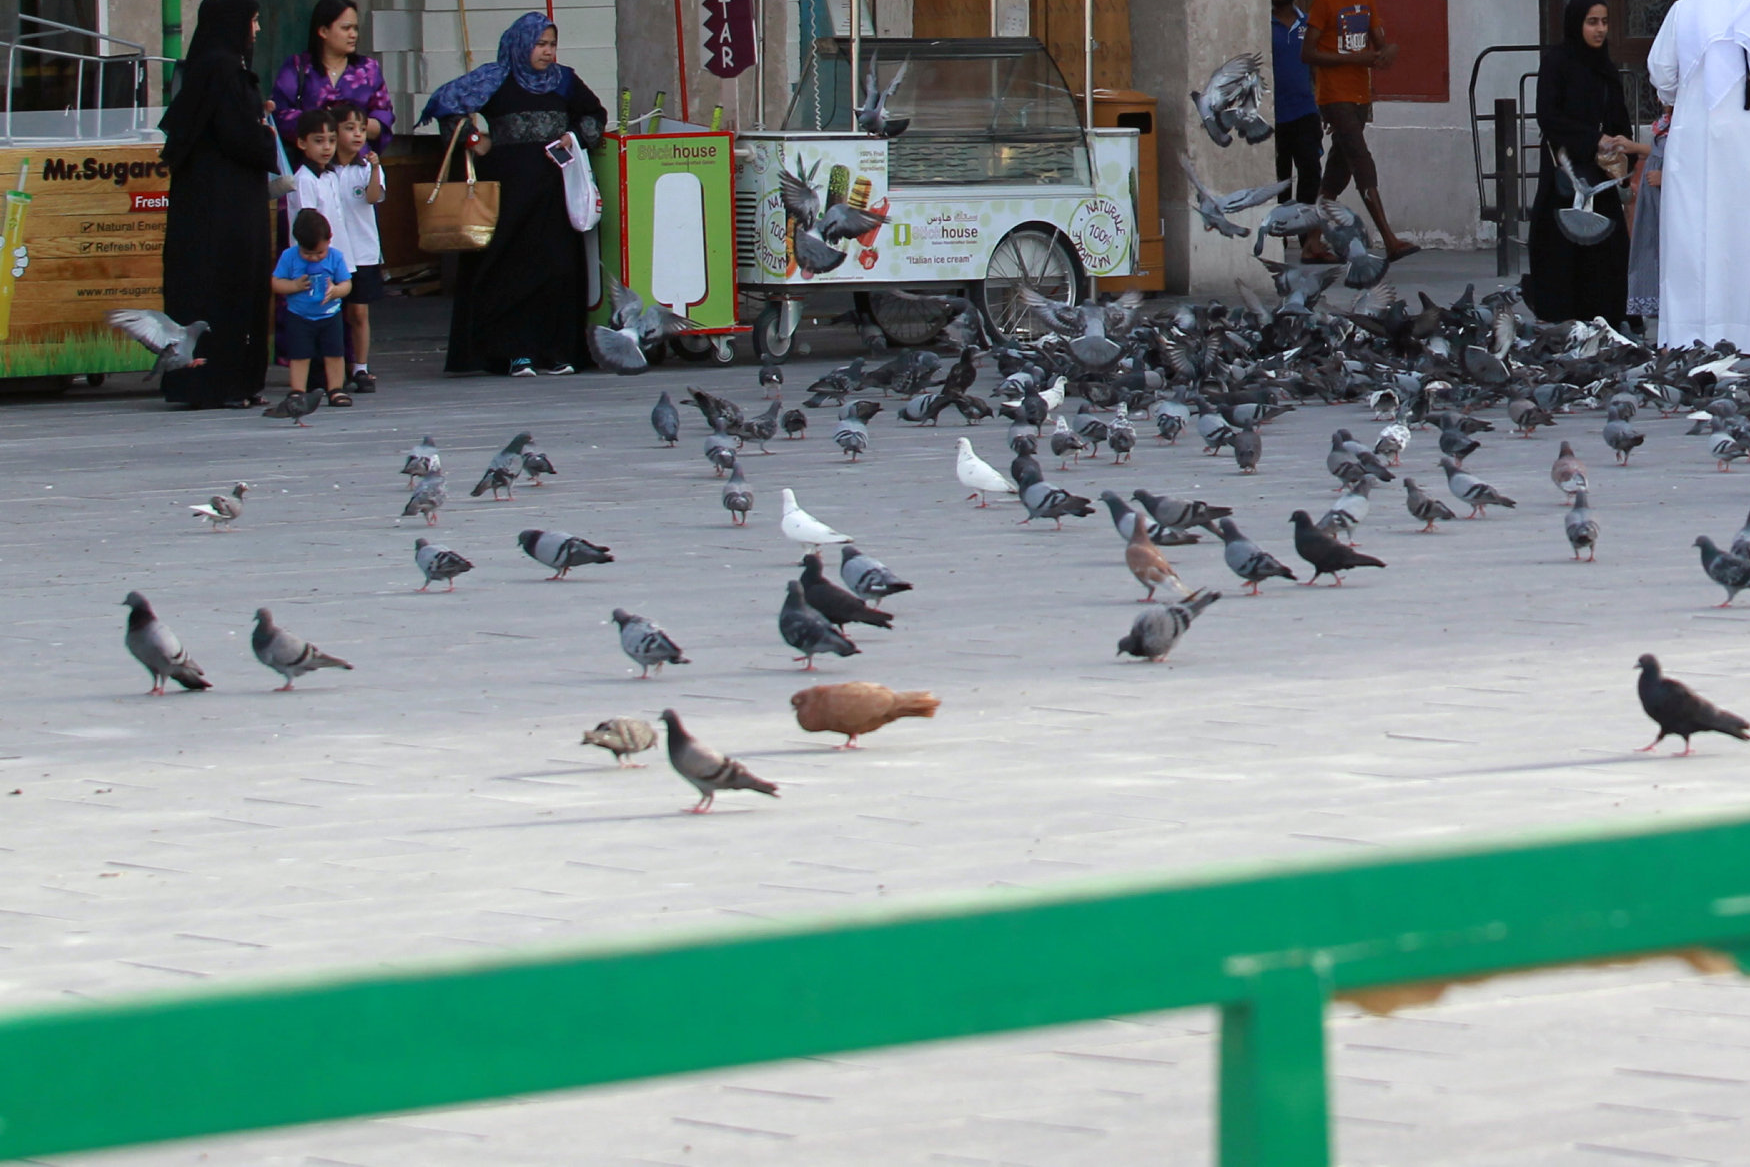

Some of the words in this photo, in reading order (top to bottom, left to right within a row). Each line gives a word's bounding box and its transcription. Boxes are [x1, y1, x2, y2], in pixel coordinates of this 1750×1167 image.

[43, 157, 170, 185] Mr.Sugarc
[134, 196, 169, 208] Fresh
[96, 221, 135, 233] Natural
[138, 221, 167, 235] Energ
[1089, 224, 1113, 245] 100%
[95, 241, 136, 253] Refresh
[934, 255, 945, 264] ice
[77, 286, 164, 298] www.mr-sugarca
